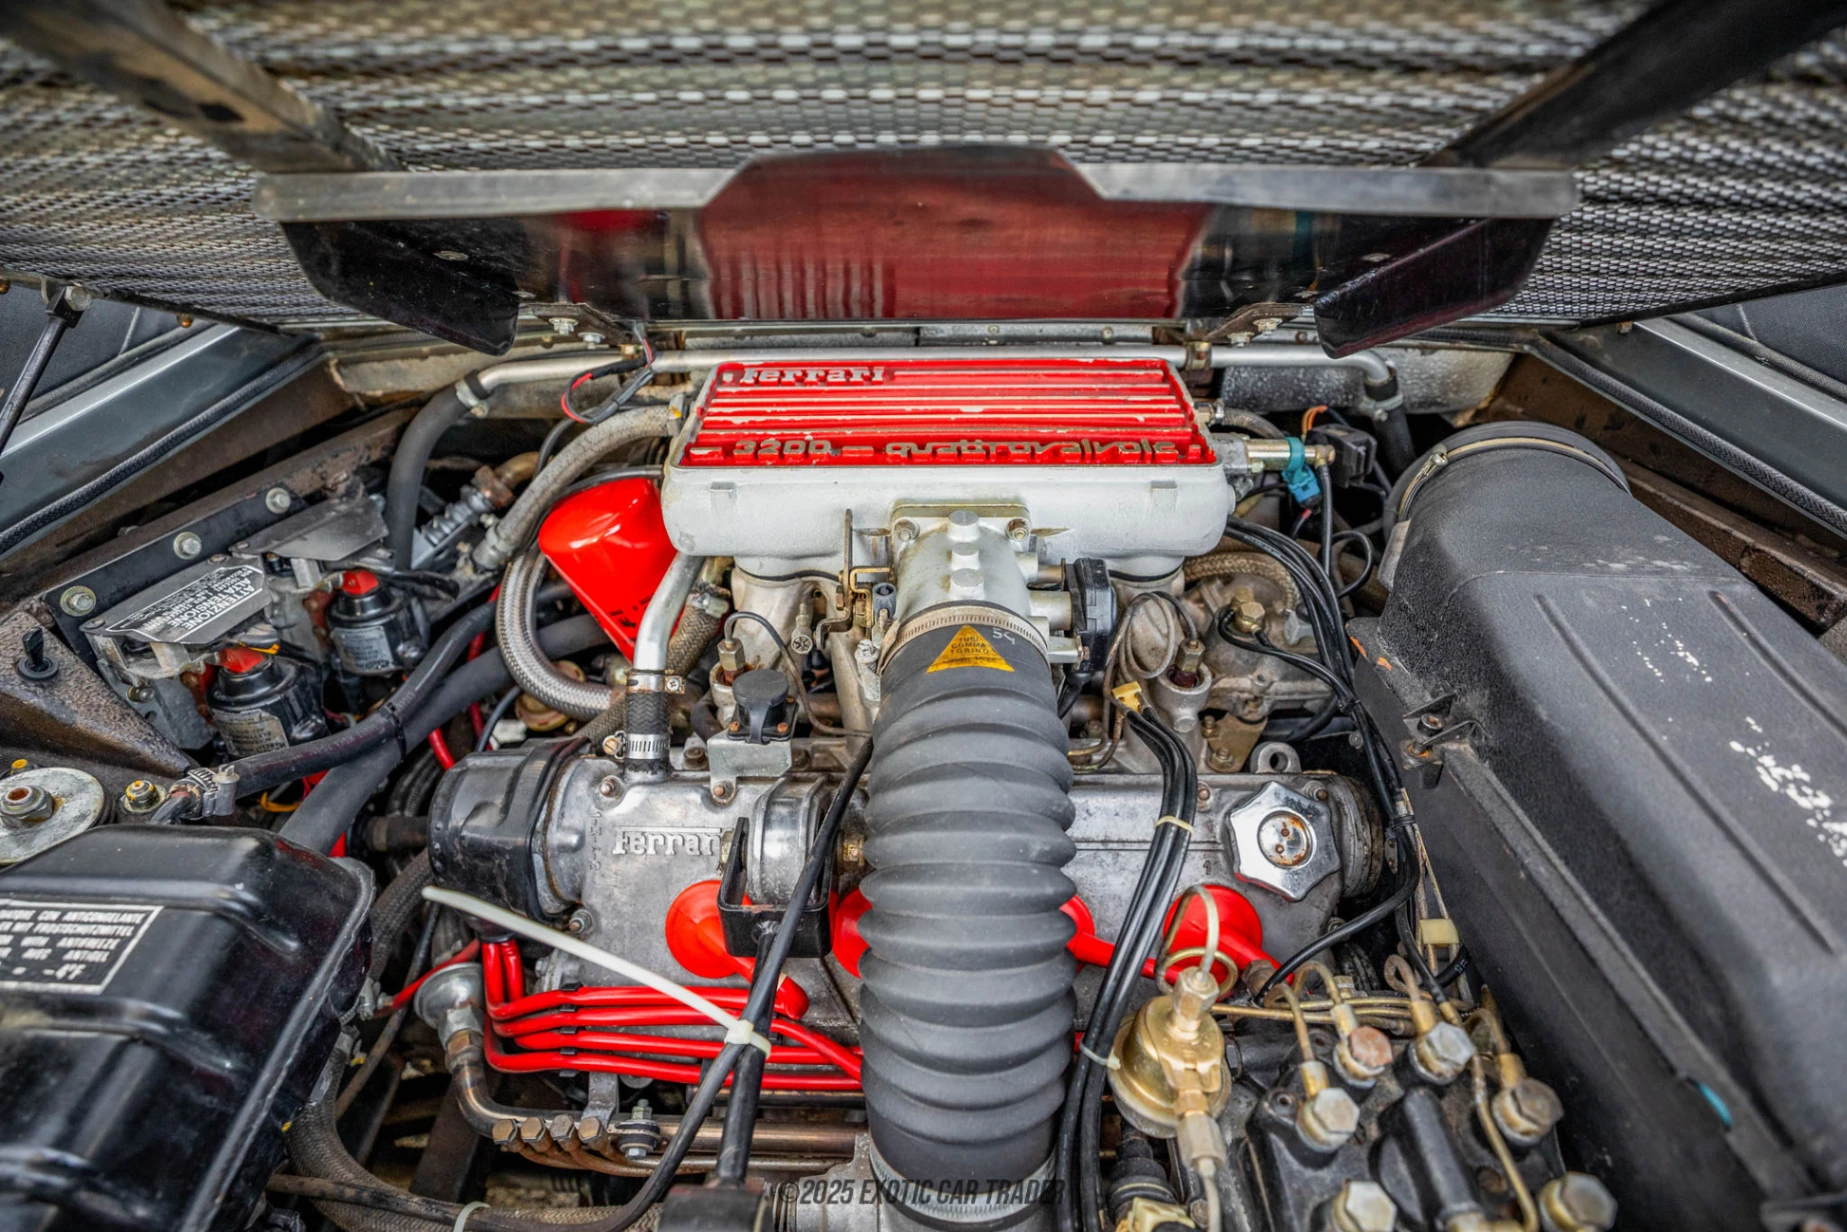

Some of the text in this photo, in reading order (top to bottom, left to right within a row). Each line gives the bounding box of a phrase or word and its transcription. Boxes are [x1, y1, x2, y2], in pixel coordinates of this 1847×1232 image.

[740, 367, 884, 385] Ferrari
[733, 440, 832, 456] 3200
[223, 577, 251, 594] ALTA
[166, 592, 225, 627] TENSIONE
[181, 584, 255, 629] ATTENZIONE
[612, 826, 721, 856] Ferrar
